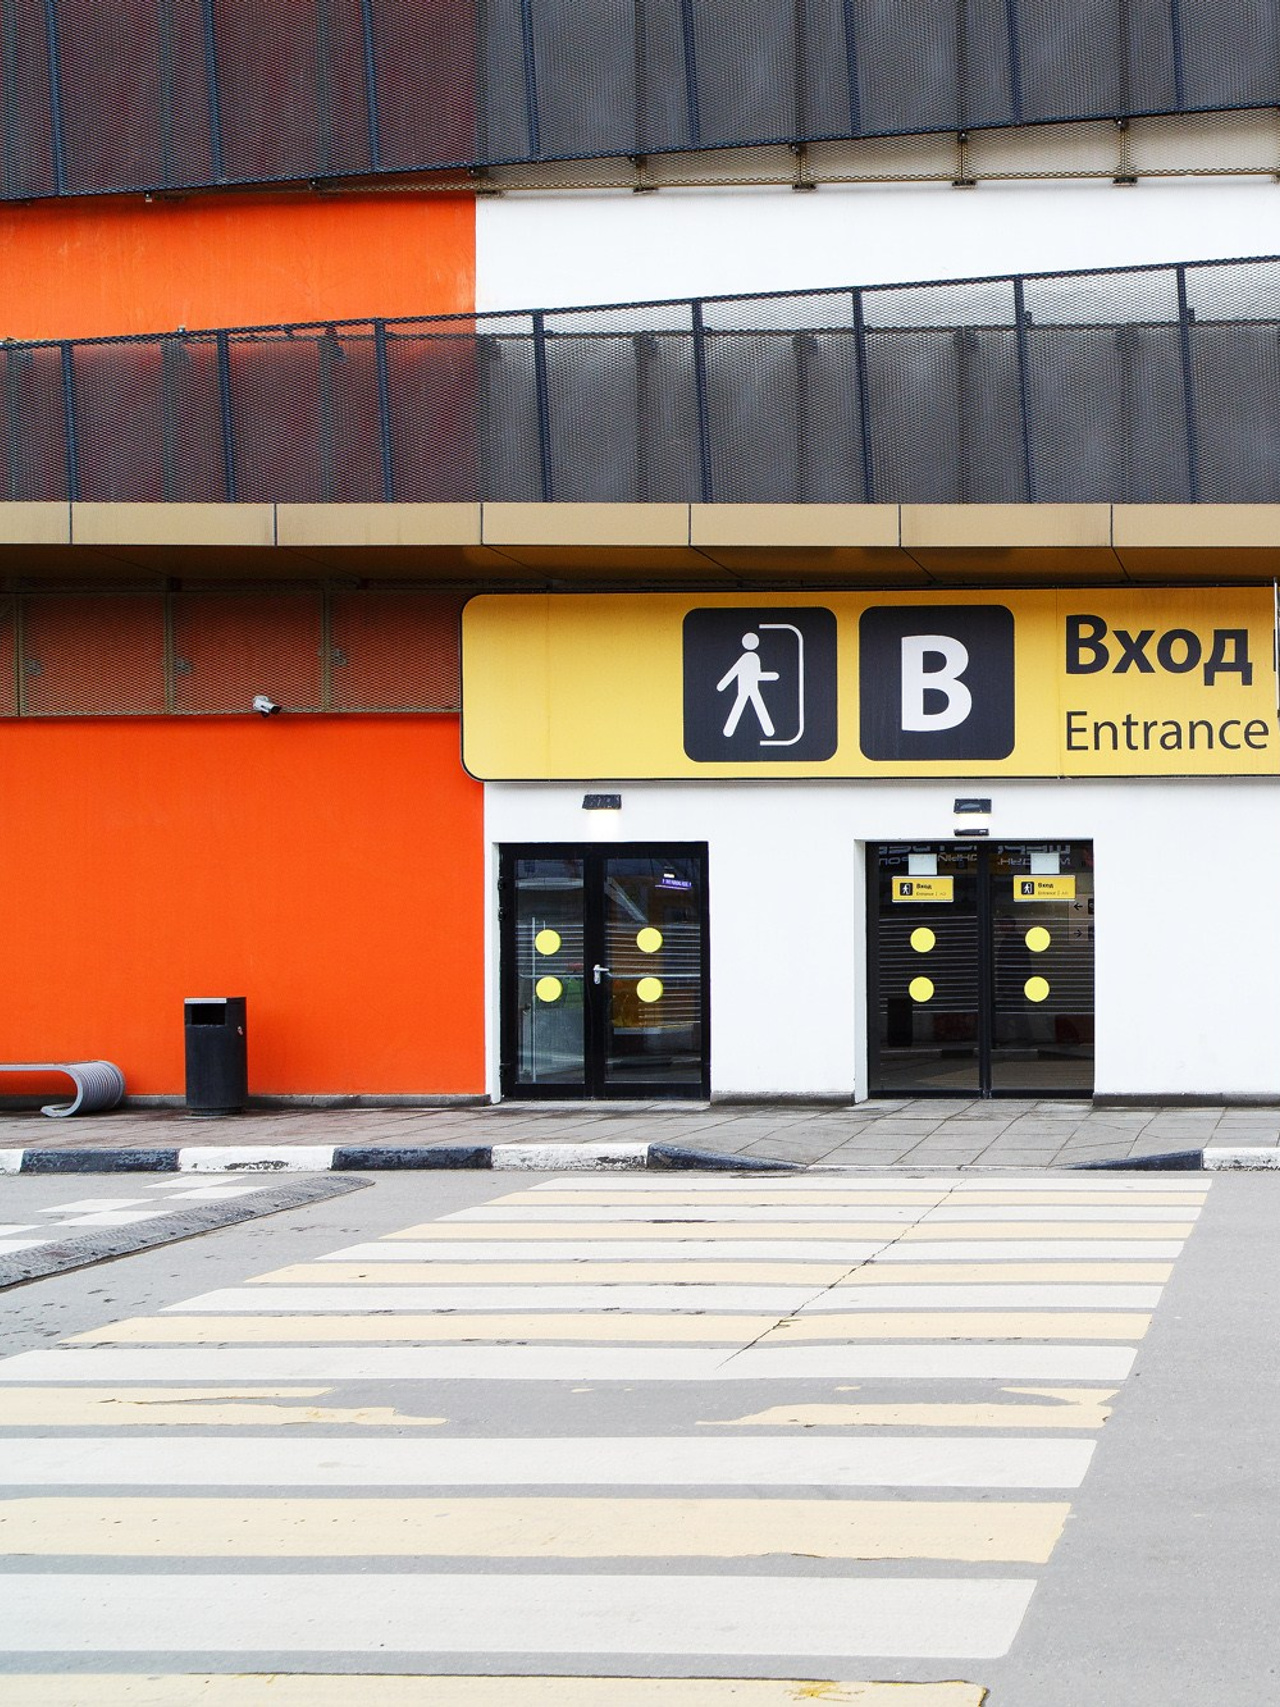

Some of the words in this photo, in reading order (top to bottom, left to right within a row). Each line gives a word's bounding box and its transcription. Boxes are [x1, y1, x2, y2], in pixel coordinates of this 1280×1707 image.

[901, 635, 973, 732] B
[1066, 613, 1254, 687] Вход
[1066, 710, 1269, 751] Entrance
